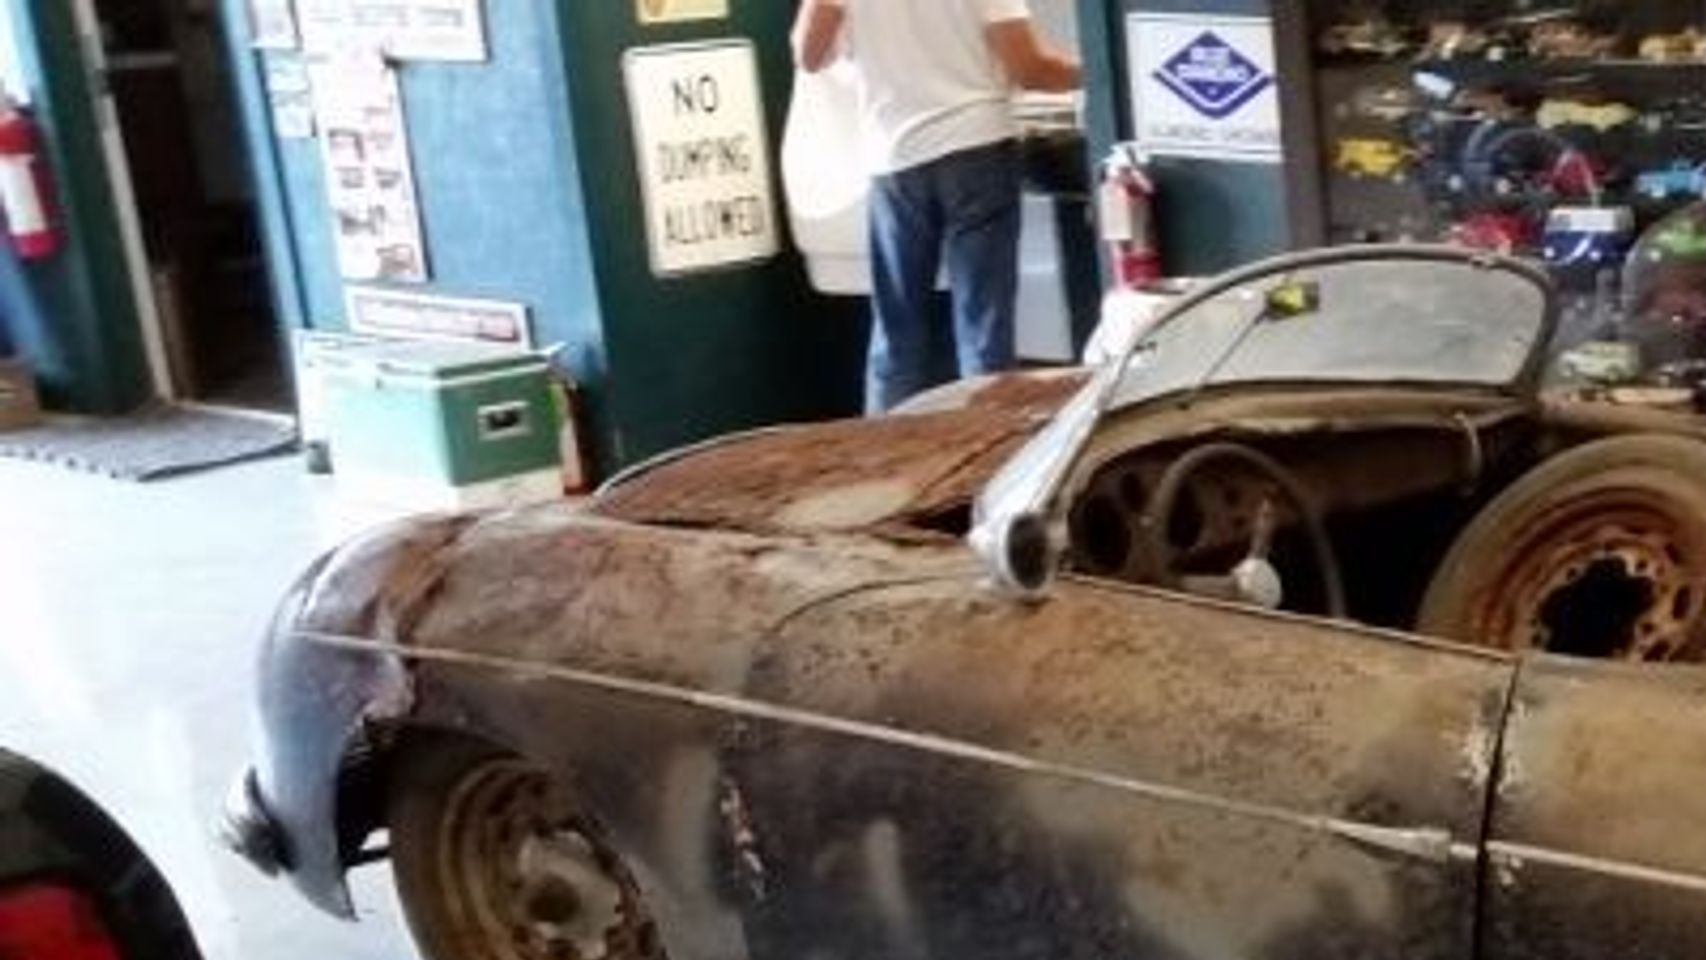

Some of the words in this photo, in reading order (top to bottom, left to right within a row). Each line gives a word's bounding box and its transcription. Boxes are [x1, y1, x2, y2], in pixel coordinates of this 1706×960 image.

[672, 72, 718, 115] NO
[657, 134, 752, 183] DUMPING
[662, 195, 766, 247] ALLOWED
